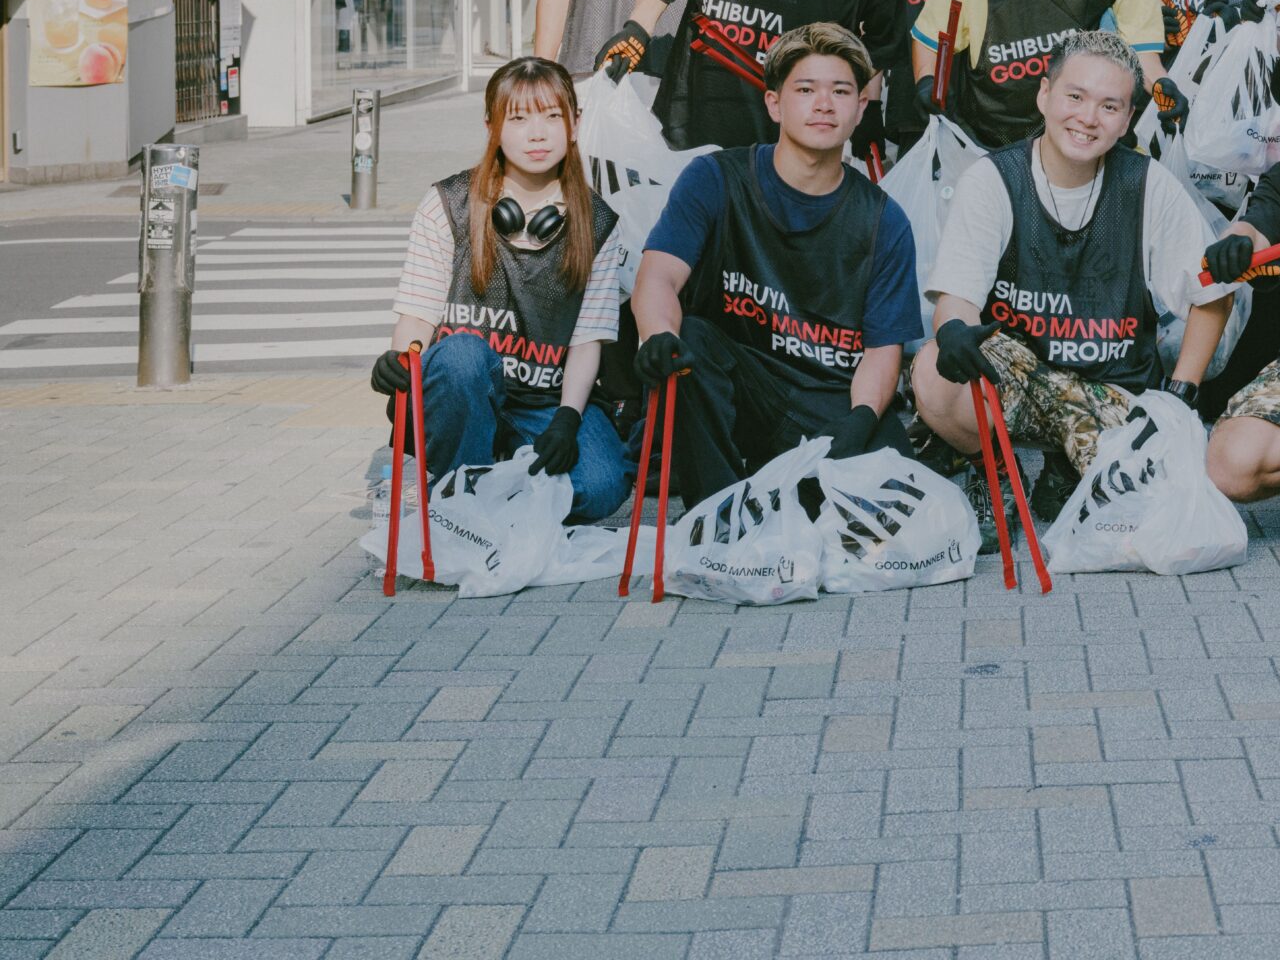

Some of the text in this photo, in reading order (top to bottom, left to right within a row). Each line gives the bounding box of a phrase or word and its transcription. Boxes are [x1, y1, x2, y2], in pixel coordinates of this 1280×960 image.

[875, 550, 945, 571] GOOD MANNER
[728, 566, 776, 577] MANNER
